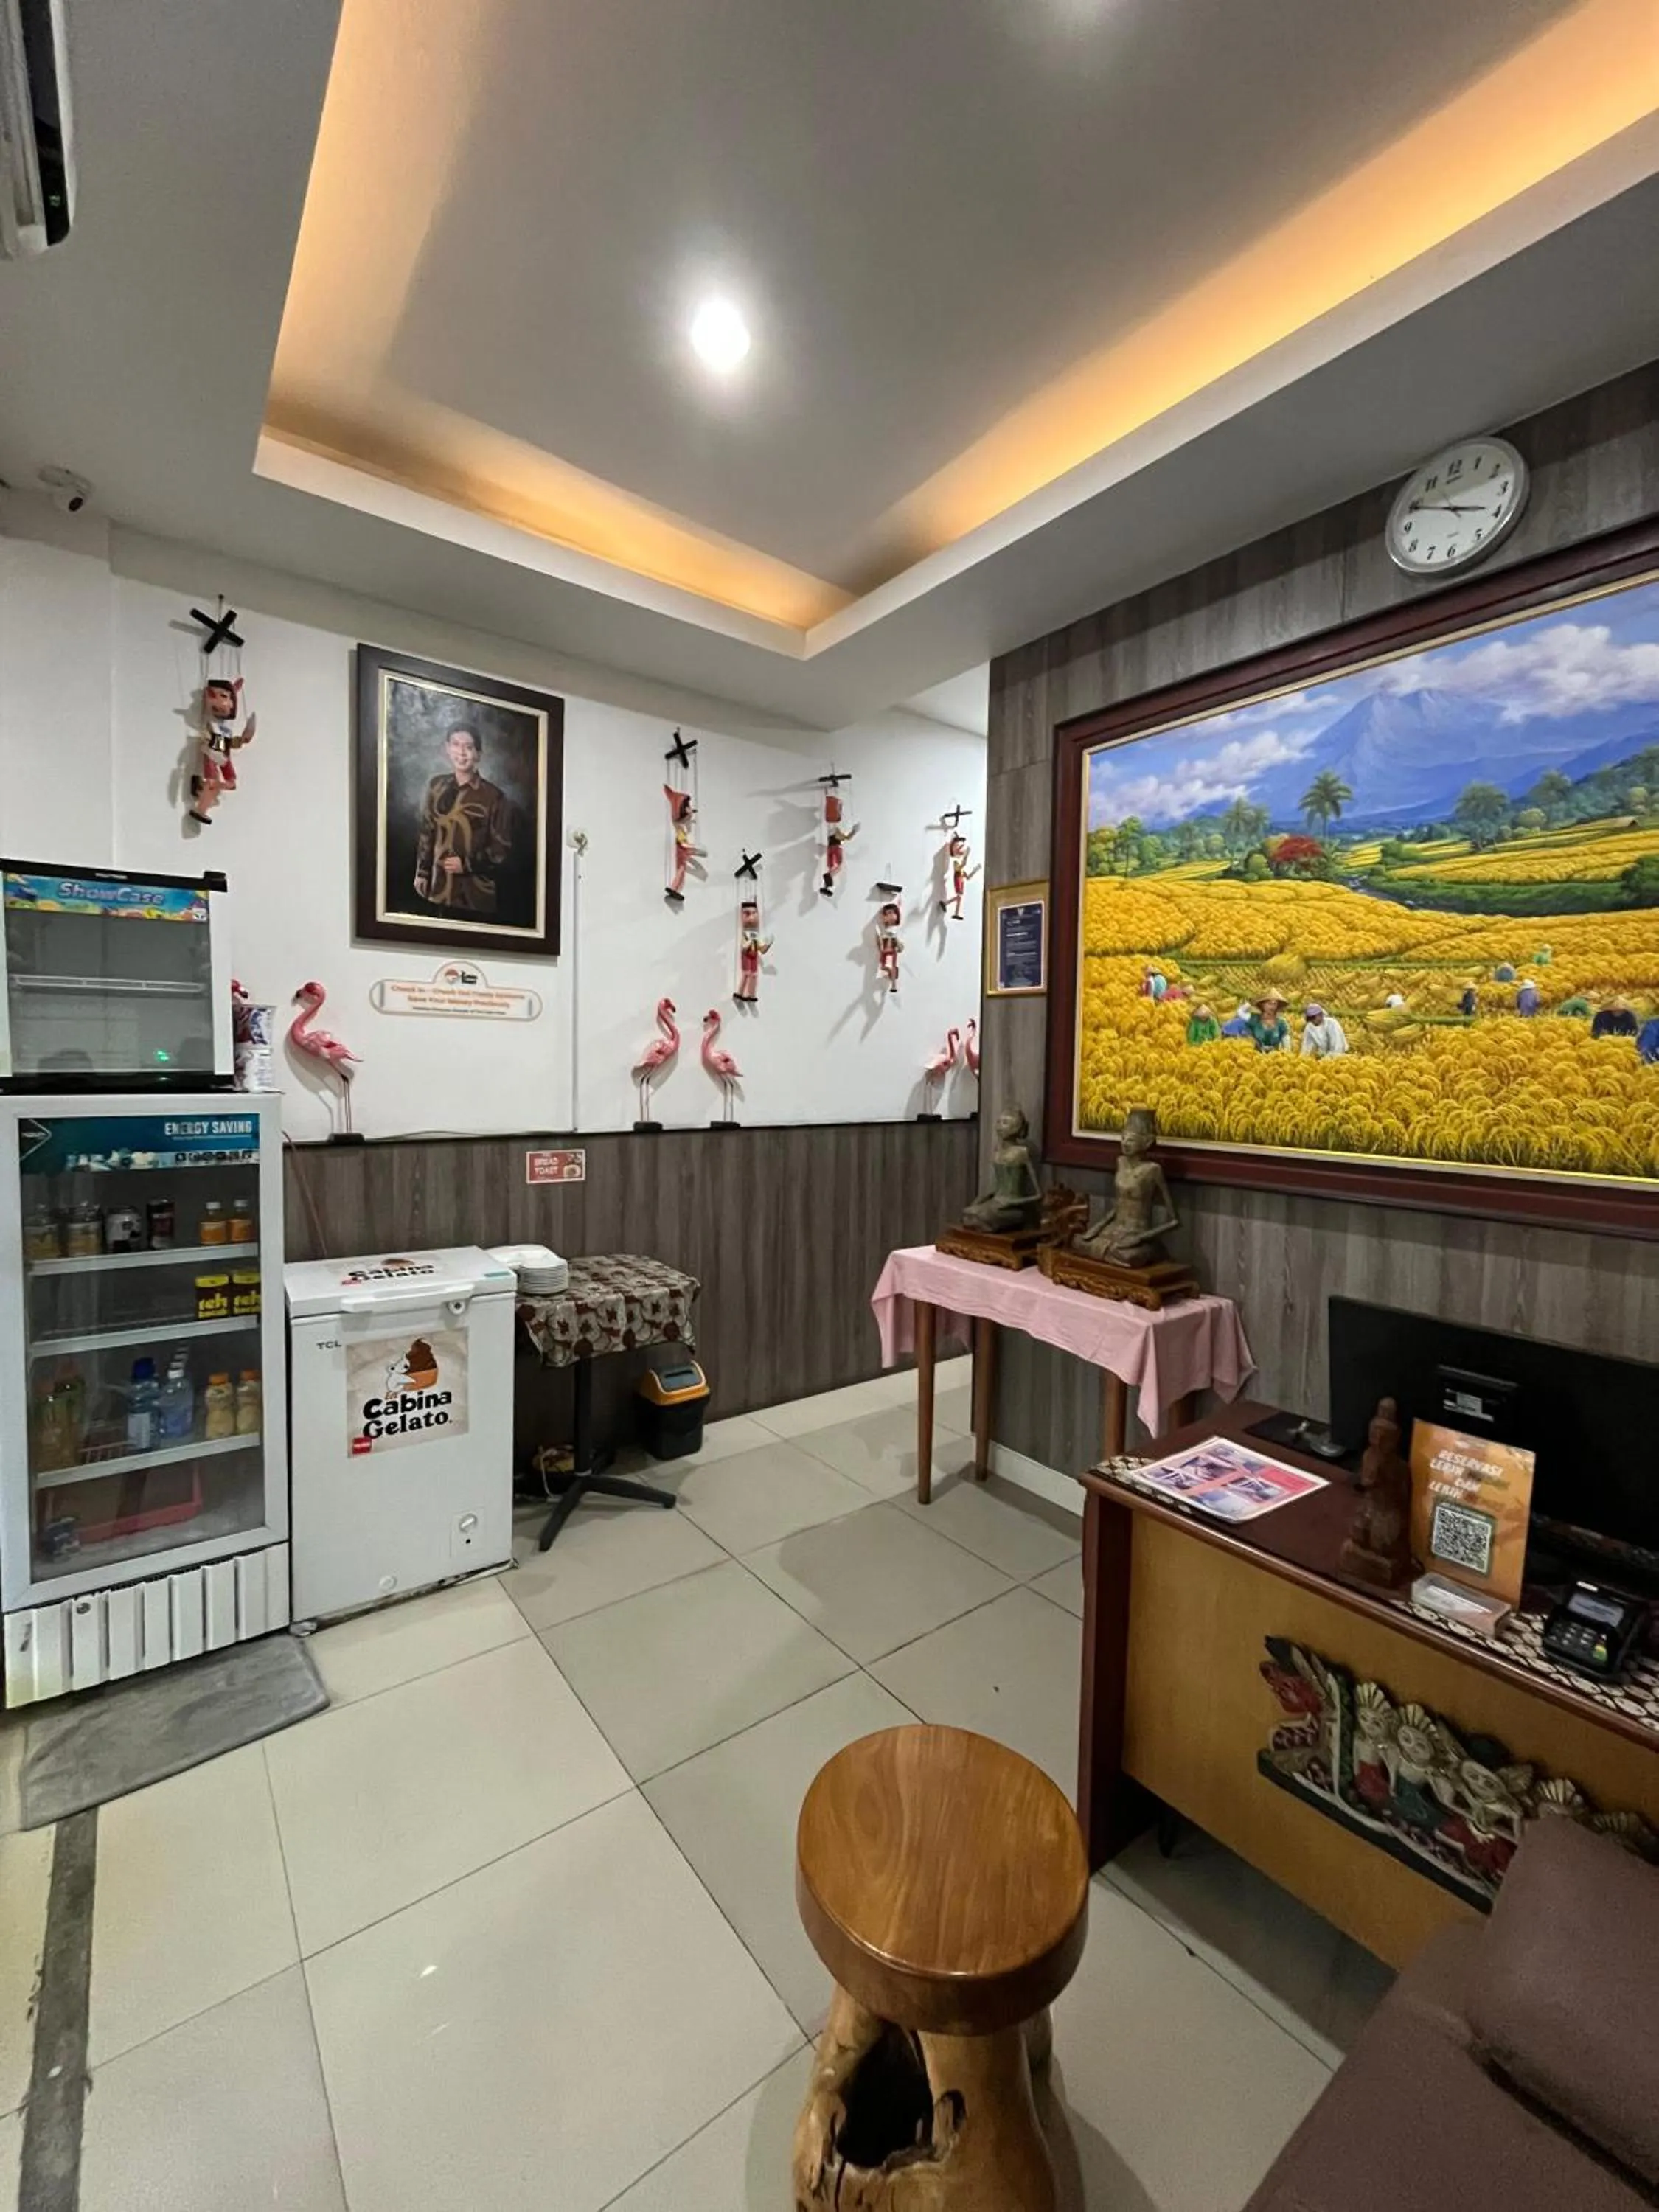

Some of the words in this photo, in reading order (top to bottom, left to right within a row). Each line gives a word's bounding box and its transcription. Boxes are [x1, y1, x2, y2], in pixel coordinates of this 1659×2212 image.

[1447, 459, 1463, 476] 12
[1475, 456, 1482, 470] 1
[1425, 476, 1438, 493] 11
[1403, 521, 1413, 534] 9
[1408, 538, 1419, 553] 8
[1427, 546, 1437, 560] 7
[1447, 544, 1457, 558] 6
[58, 883, 164, 904] ShowCase
[164, 1121, 209, 1136] ENERGY
[211, 1120, 252, 1133] SAVING
[316, 1341, 342, 1350] TCL
[363, 1391, 452, 1420] Cabina
